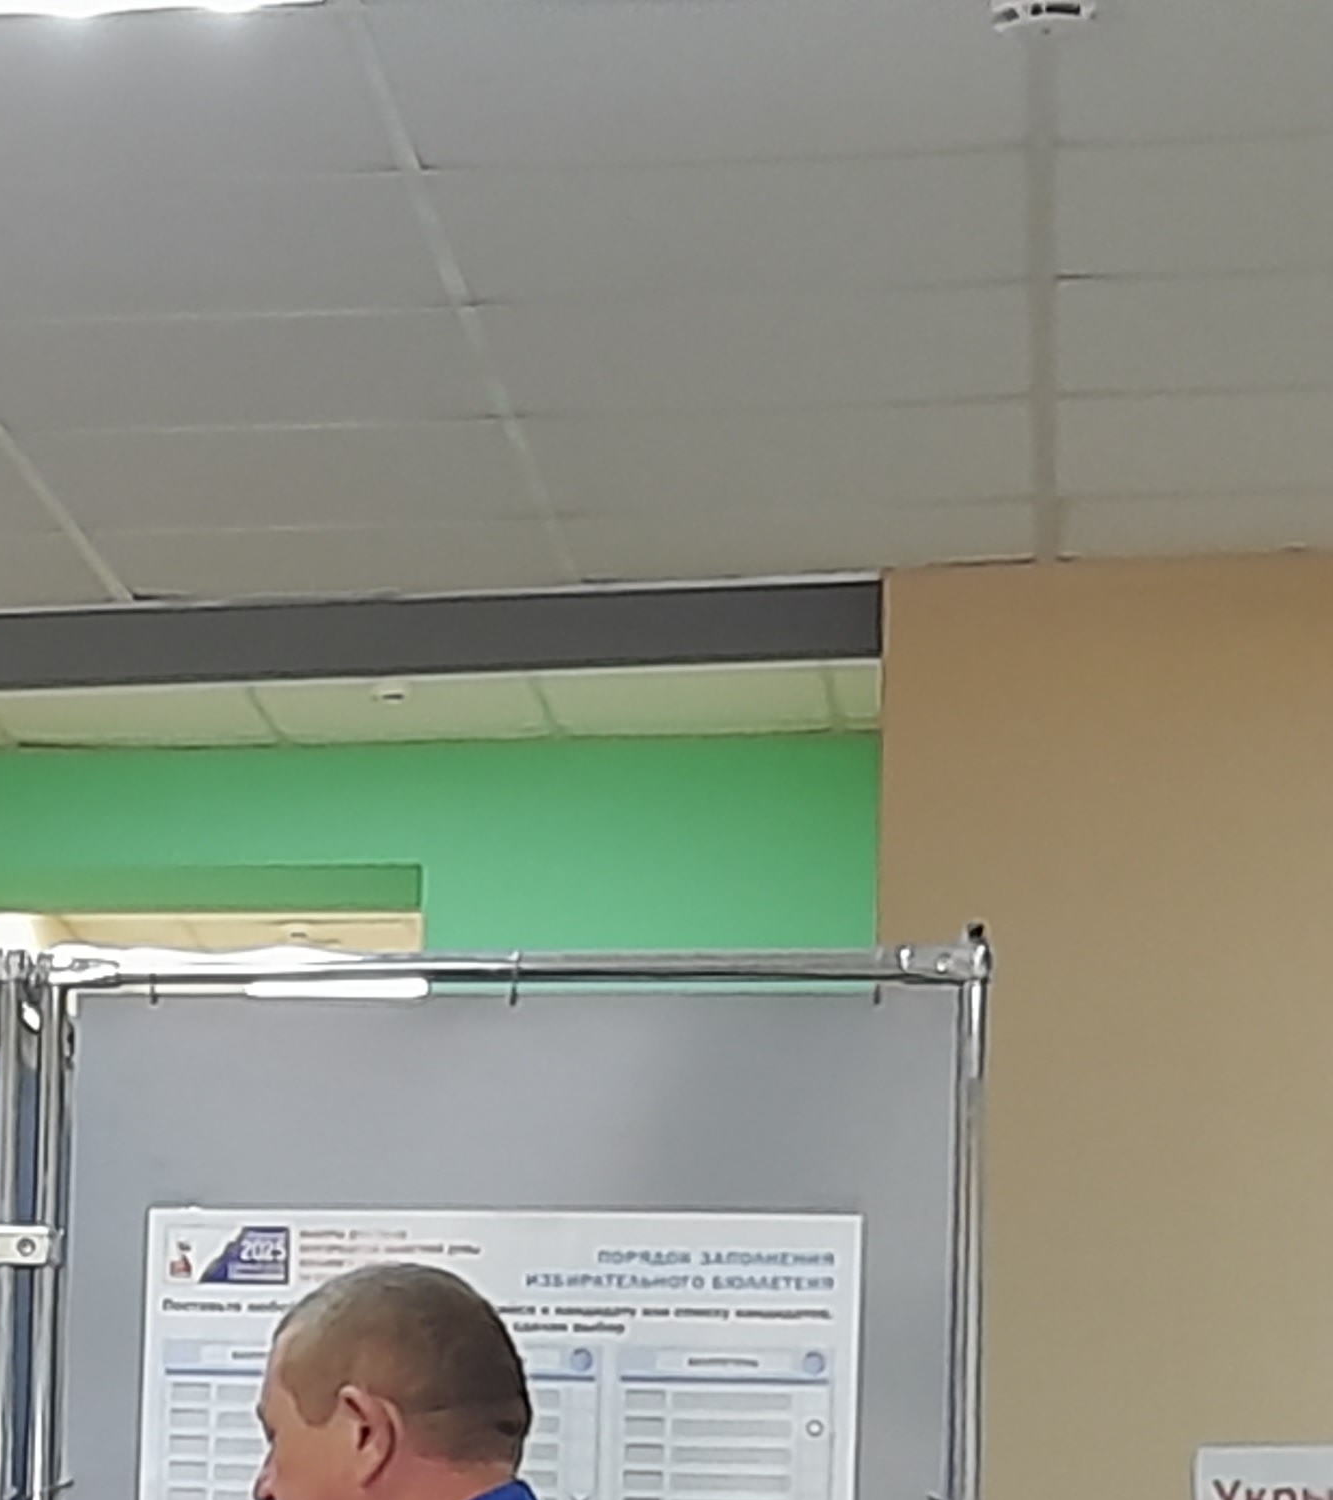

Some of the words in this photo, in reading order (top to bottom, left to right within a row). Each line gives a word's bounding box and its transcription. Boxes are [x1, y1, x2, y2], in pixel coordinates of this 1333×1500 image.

[239, 1238, 287, 1262] 2025
[597, 1250, 692, 1267] ПОРЯДОК
[700, 1251, 835, 1267] ЗАПОЛНЕНИЯ
[526, 1273, 706, 1290] ИЗБИРАТЕЛЬНОГО
[712, 1275, 835, 1291] БЮЛЛЕТЕНЯ
